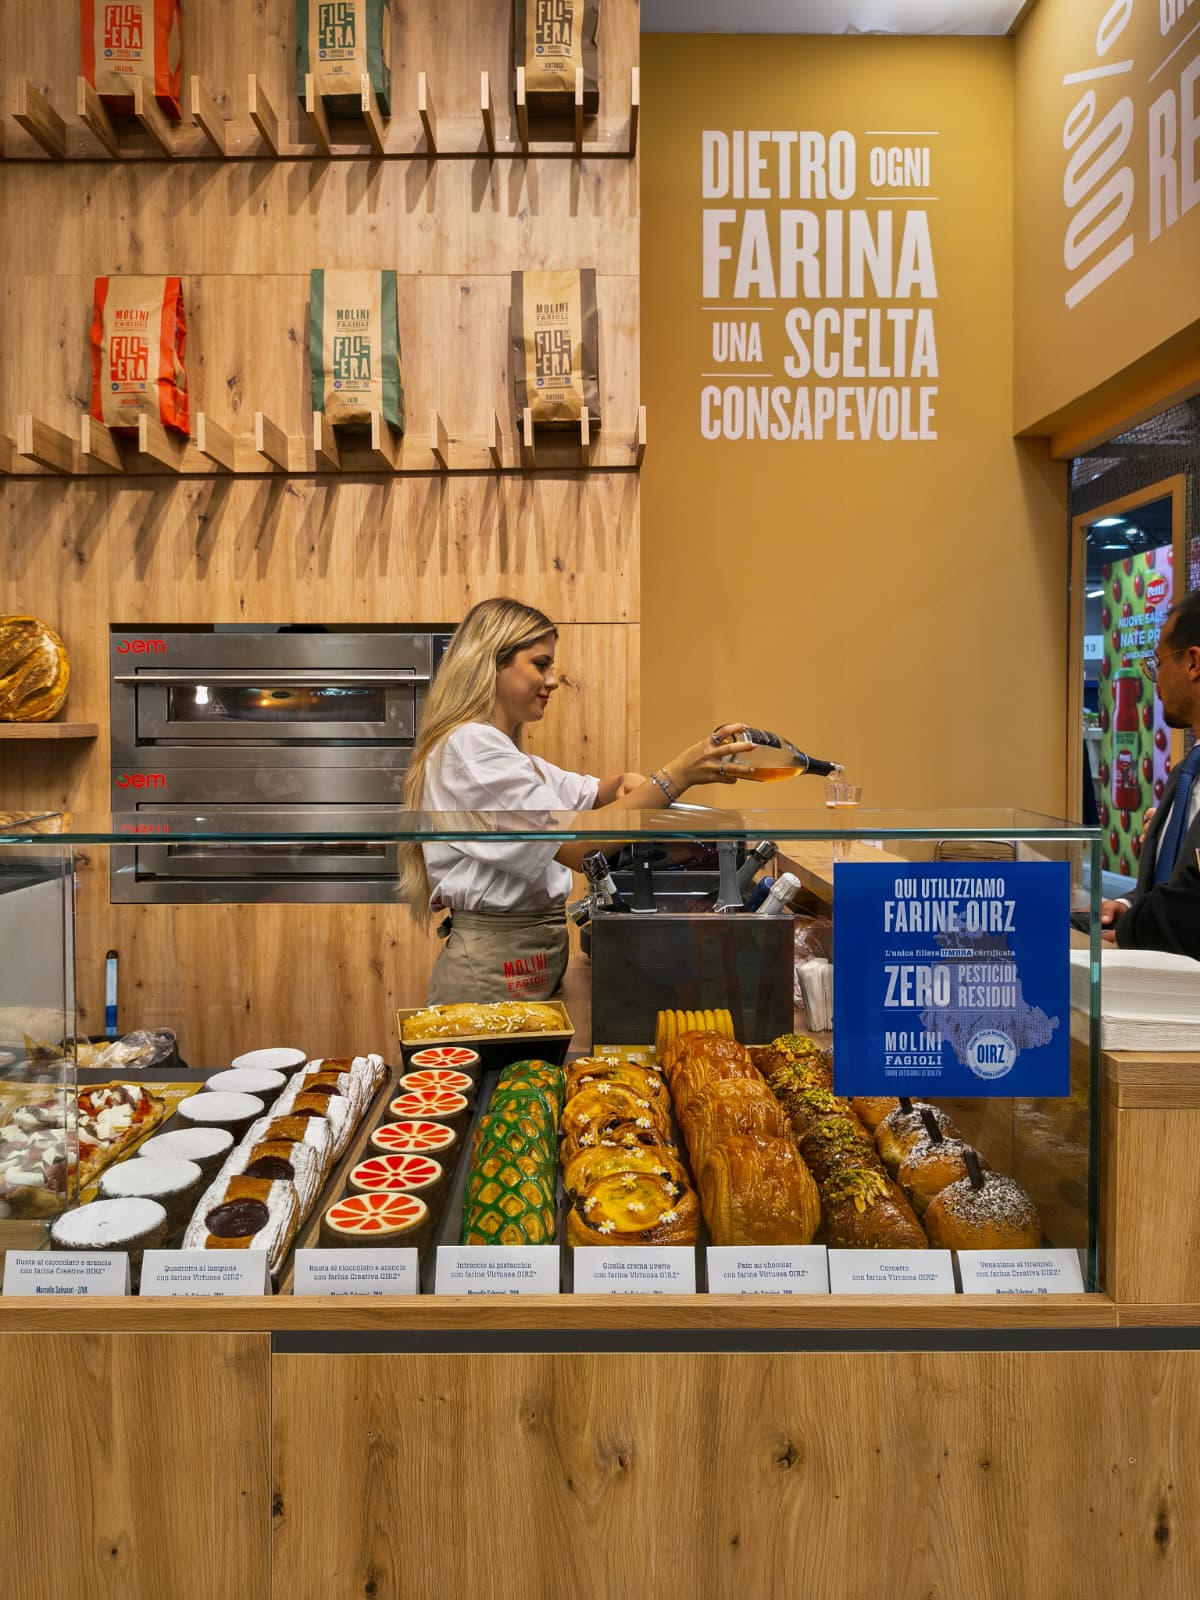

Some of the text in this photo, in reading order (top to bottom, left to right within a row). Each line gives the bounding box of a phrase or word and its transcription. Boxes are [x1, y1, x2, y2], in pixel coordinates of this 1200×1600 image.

[702, 130, 930, 200] DIETRO OGNI
[702, 209, 938, 298] FARINA
[115, 309, 150, 320] MOLINI
[336, 308, 370, 320] MOLINI
[536, 302, 569, 314] MOLINI
[712, 307, 939, 379] UNA SCELTA
[700, 385, 939, 441] CONSAPEVOLE
[1119, 614, 1144, 628] NUOVE
[116, 639, 167, 655] oem
[1120, 627, 1161, 647] NATE PR
[116, 773, 167, 789] oem
[894, 878, 1005, 899] QUI UTILIZZIAMO
[884, 901, 1016, 933] FARINE OIRZ
[885, 949, 1016, 957] L'unica filiera UMBRA certificata
[503, 951, 548, 979] MOLINI
[884, 964, 1017, 1008] ZERO PESTICIDI
[958, 985, 1017, 1008] RESIDUI
[885, 1031, 942, 1052] MOLINI
[885, 1055, 942, 1065] FAGIOLI
[977, 1044, 1005, 1064] OIRZ
[45, 1258, 79, 1266] cioccolato
[86, 1258, 112, 1266] arancia
